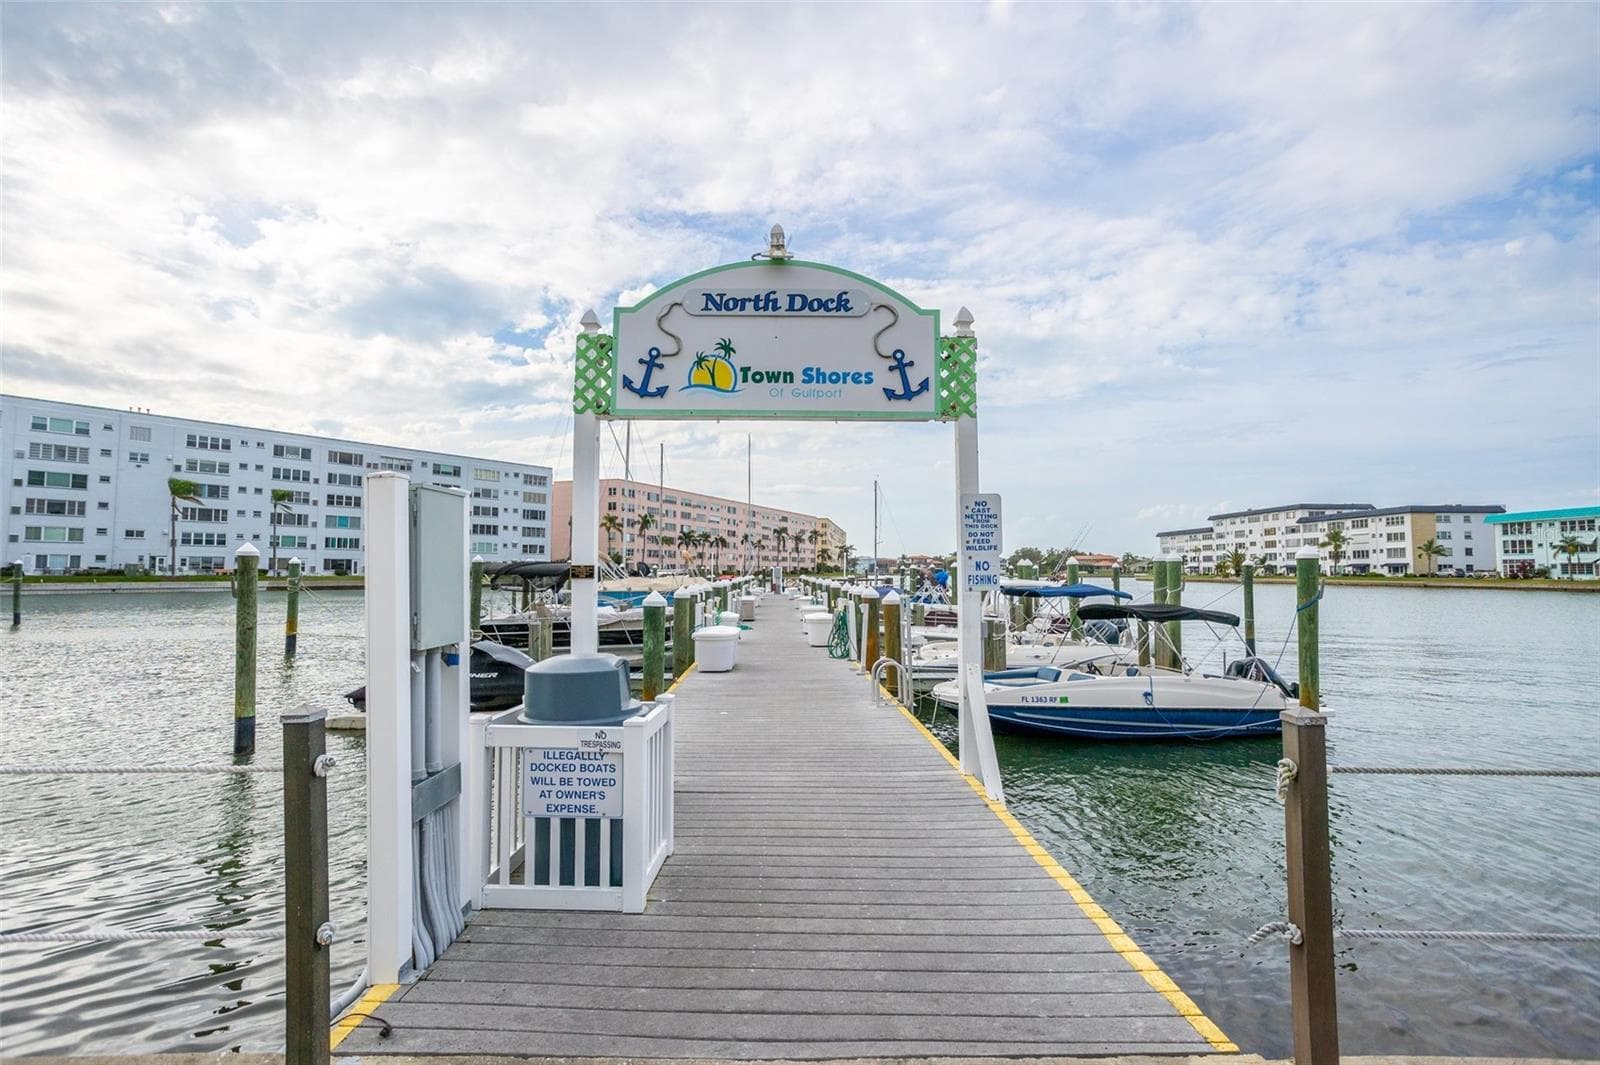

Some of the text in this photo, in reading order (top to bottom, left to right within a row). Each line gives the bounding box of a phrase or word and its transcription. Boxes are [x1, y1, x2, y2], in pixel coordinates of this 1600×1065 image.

[700, 290, 854, 313] North Dock
[740, 366, 874, 385] Town Shores
[769, 387, 842, 399] Of Gulfport
[975, 561, 990, 571] NO
[967, 575, 998, 586] FISHING
[595, 731, 607, 740] NO
[581, 740, 621, 749] TRESPASSING
[530, 763, 616, 773] DOCKED BOATS
[530, 776, 616, 787] WILL BE TOWED
[539, 790, 606, 800] AT OWNER'S
[546, 804, 599, 814] EXPENSE.
